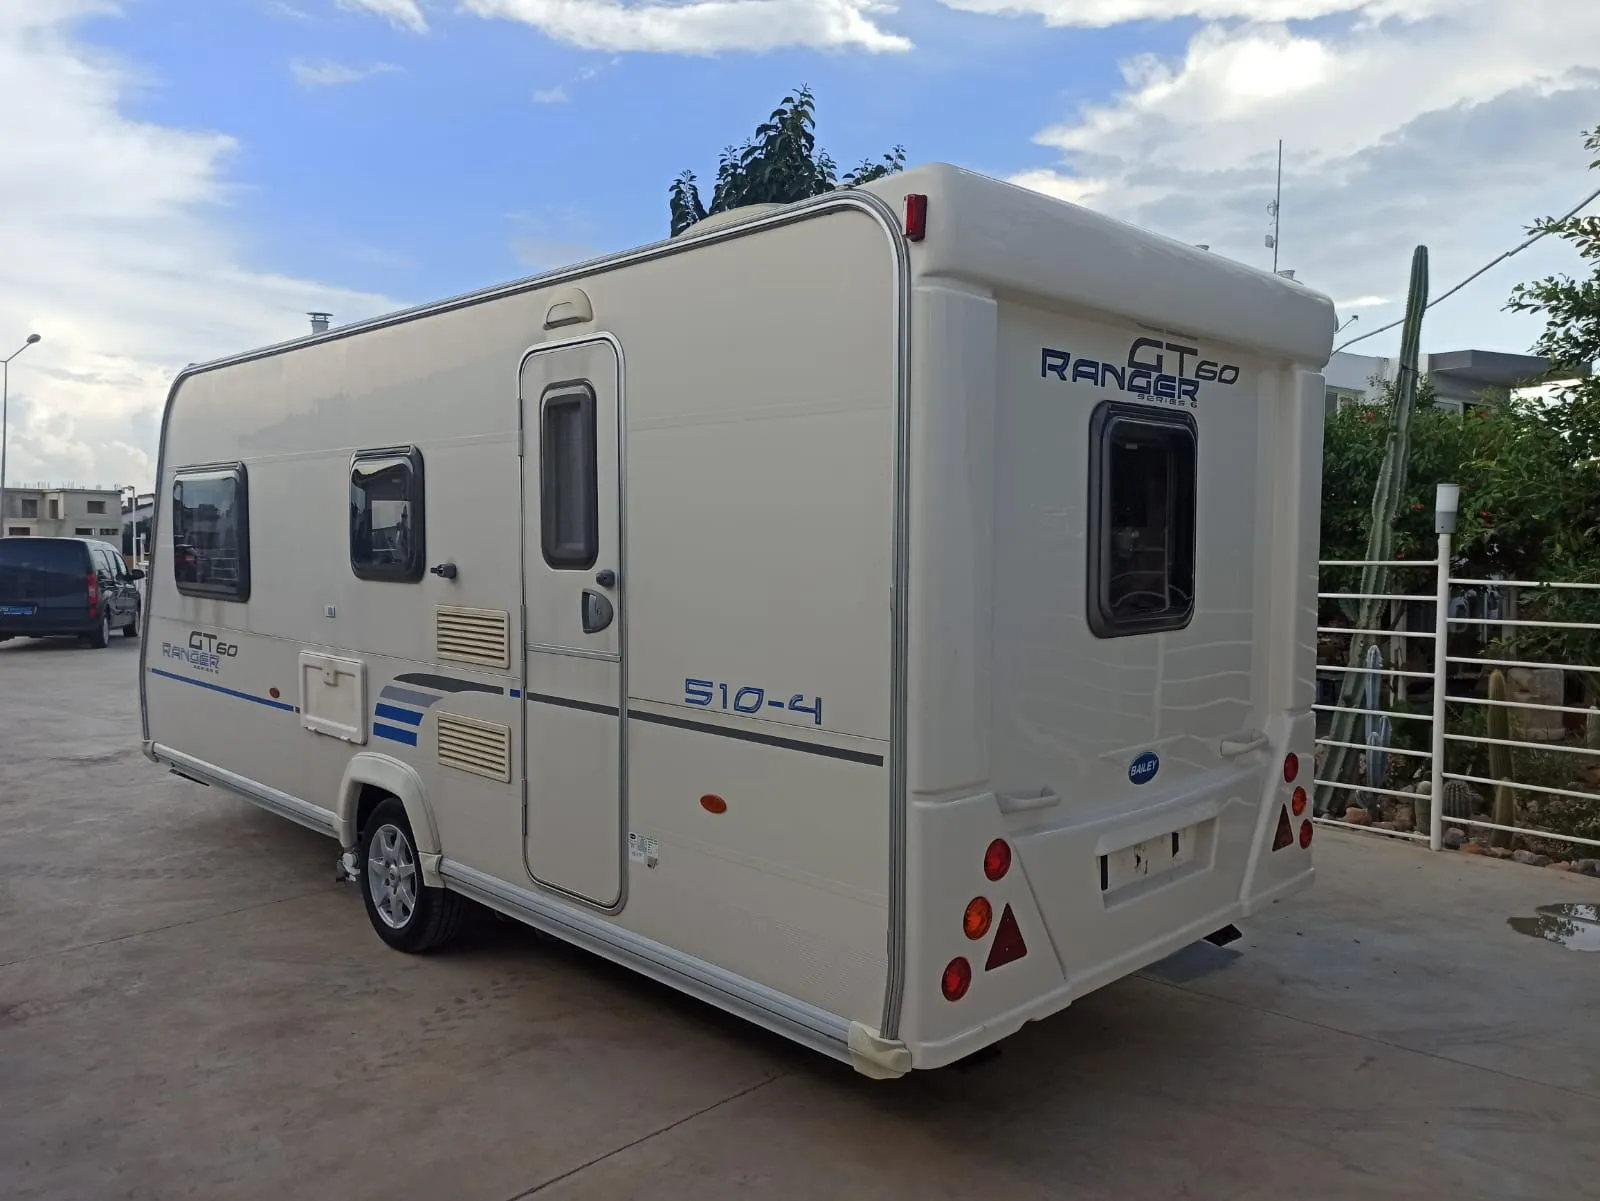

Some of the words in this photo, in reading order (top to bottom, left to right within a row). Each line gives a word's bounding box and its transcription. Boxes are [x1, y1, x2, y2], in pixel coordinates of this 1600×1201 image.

[1041, 347, 1200, 402] RANGER
[1137, 393, 1186, 407] SERIES
[162, 641, 220, 669] RANGER
[685, 678, 822, 725] 510-4
[1130, 759, 1157, 777] BAILEY
